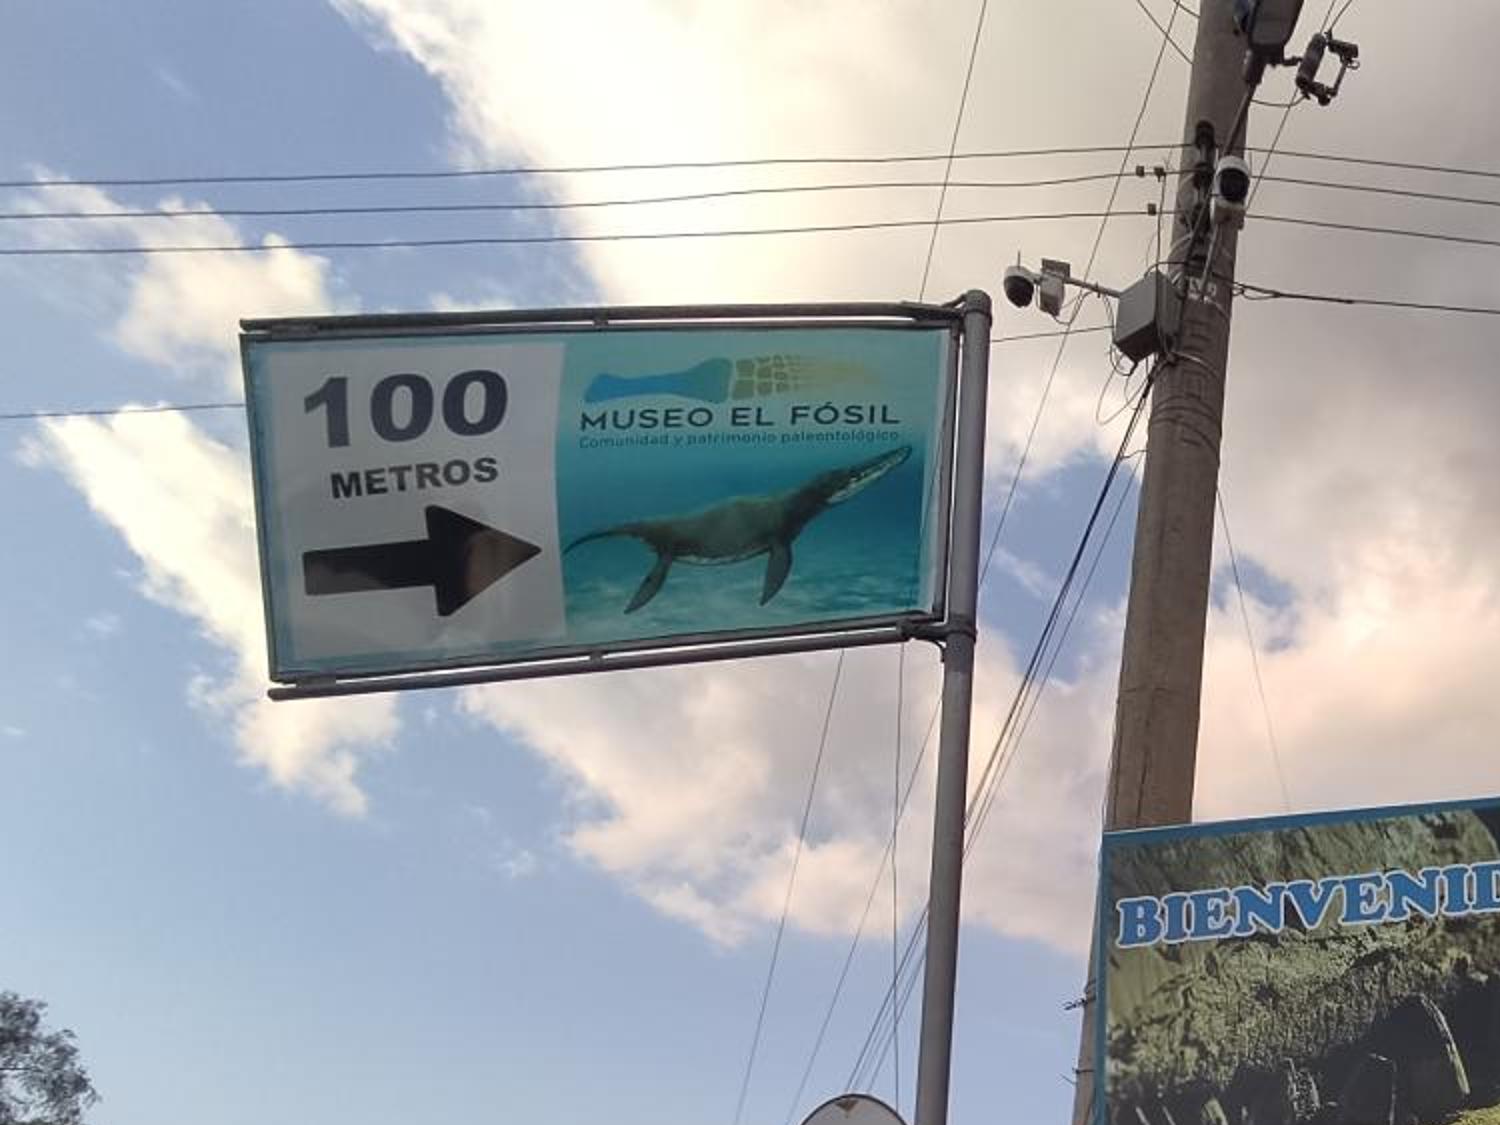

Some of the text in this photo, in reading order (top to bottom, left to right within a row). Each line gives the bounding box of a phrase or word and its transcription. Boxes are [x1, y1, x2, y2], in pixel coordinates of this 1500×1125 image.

[304, 370, 508, 448] 100
[580, 402, 900, 431] MUSEO EL FÓSIL
[579, 429, 899, 448] Comunidad y patrimonio paleontológico
[330, 457, 499, 500] METROS
